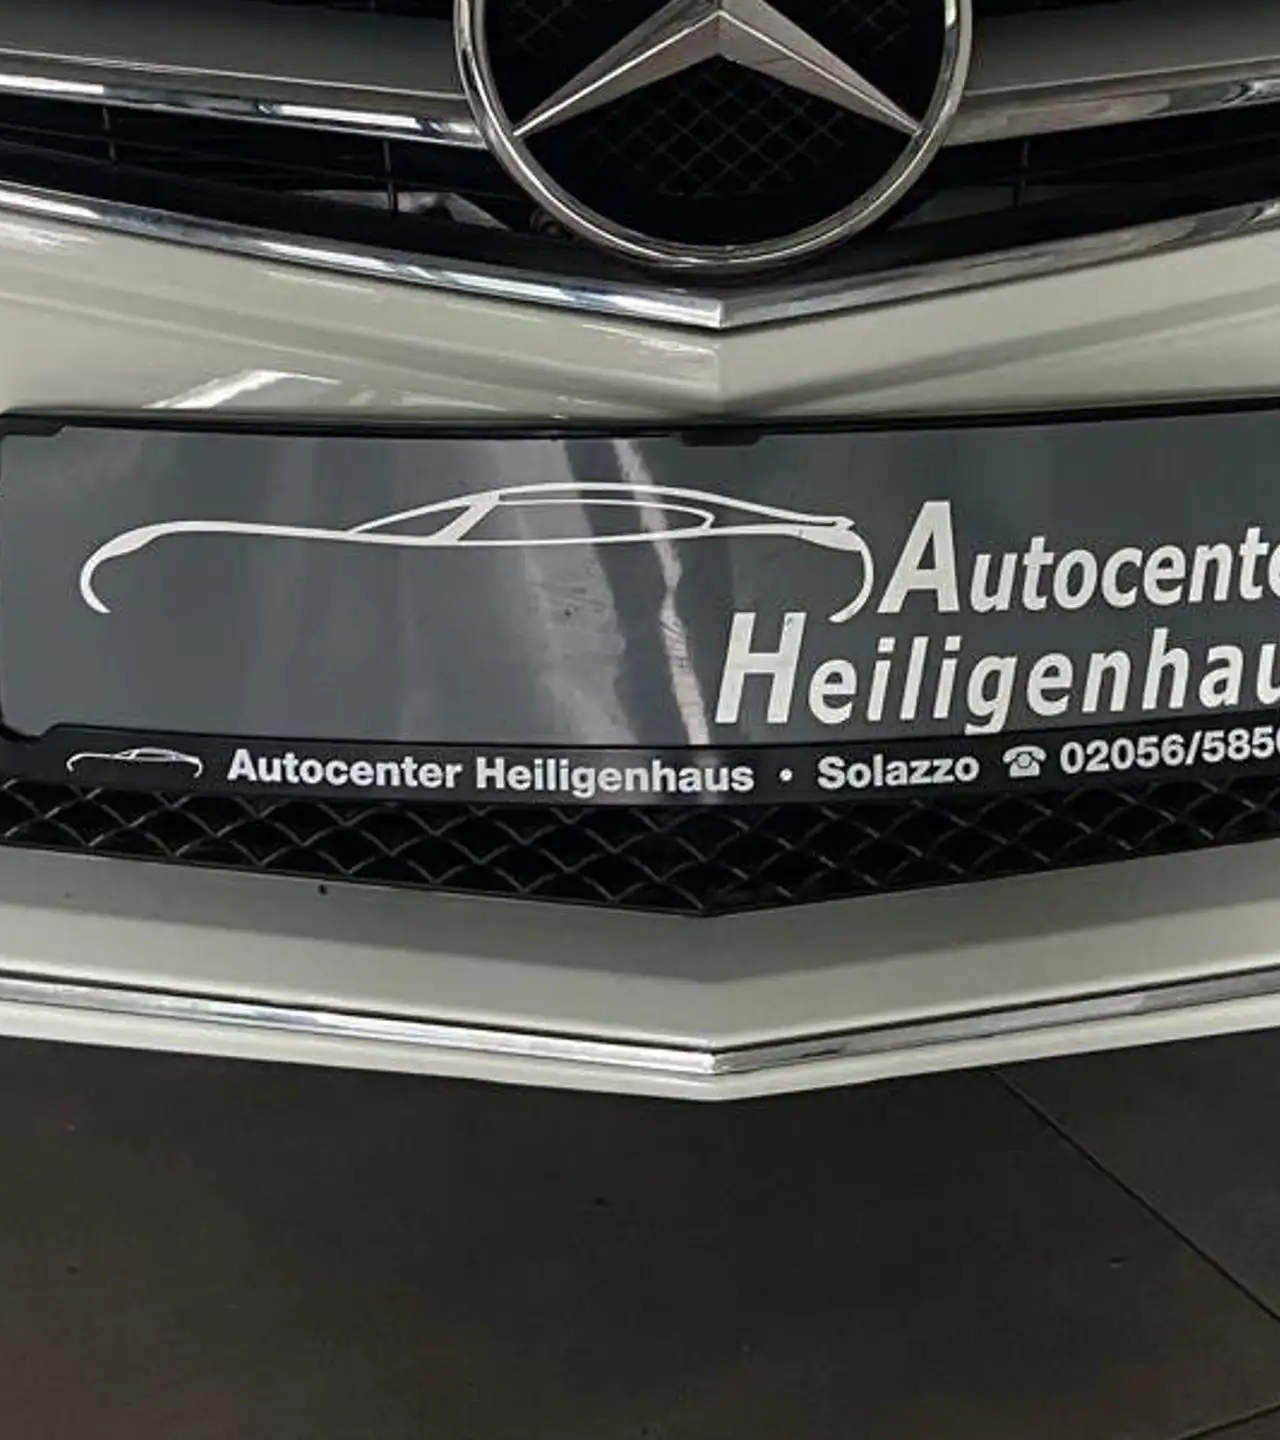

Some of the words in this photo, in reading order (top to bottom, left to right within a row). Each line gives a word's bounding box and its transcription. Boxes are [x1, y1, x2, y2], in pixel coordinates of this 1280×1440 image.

[227, 748, 463, 788] Autocenter
[476, 756, 755, 799] Heiligenhaus
[818, 754, 980, 789] Solazzo
